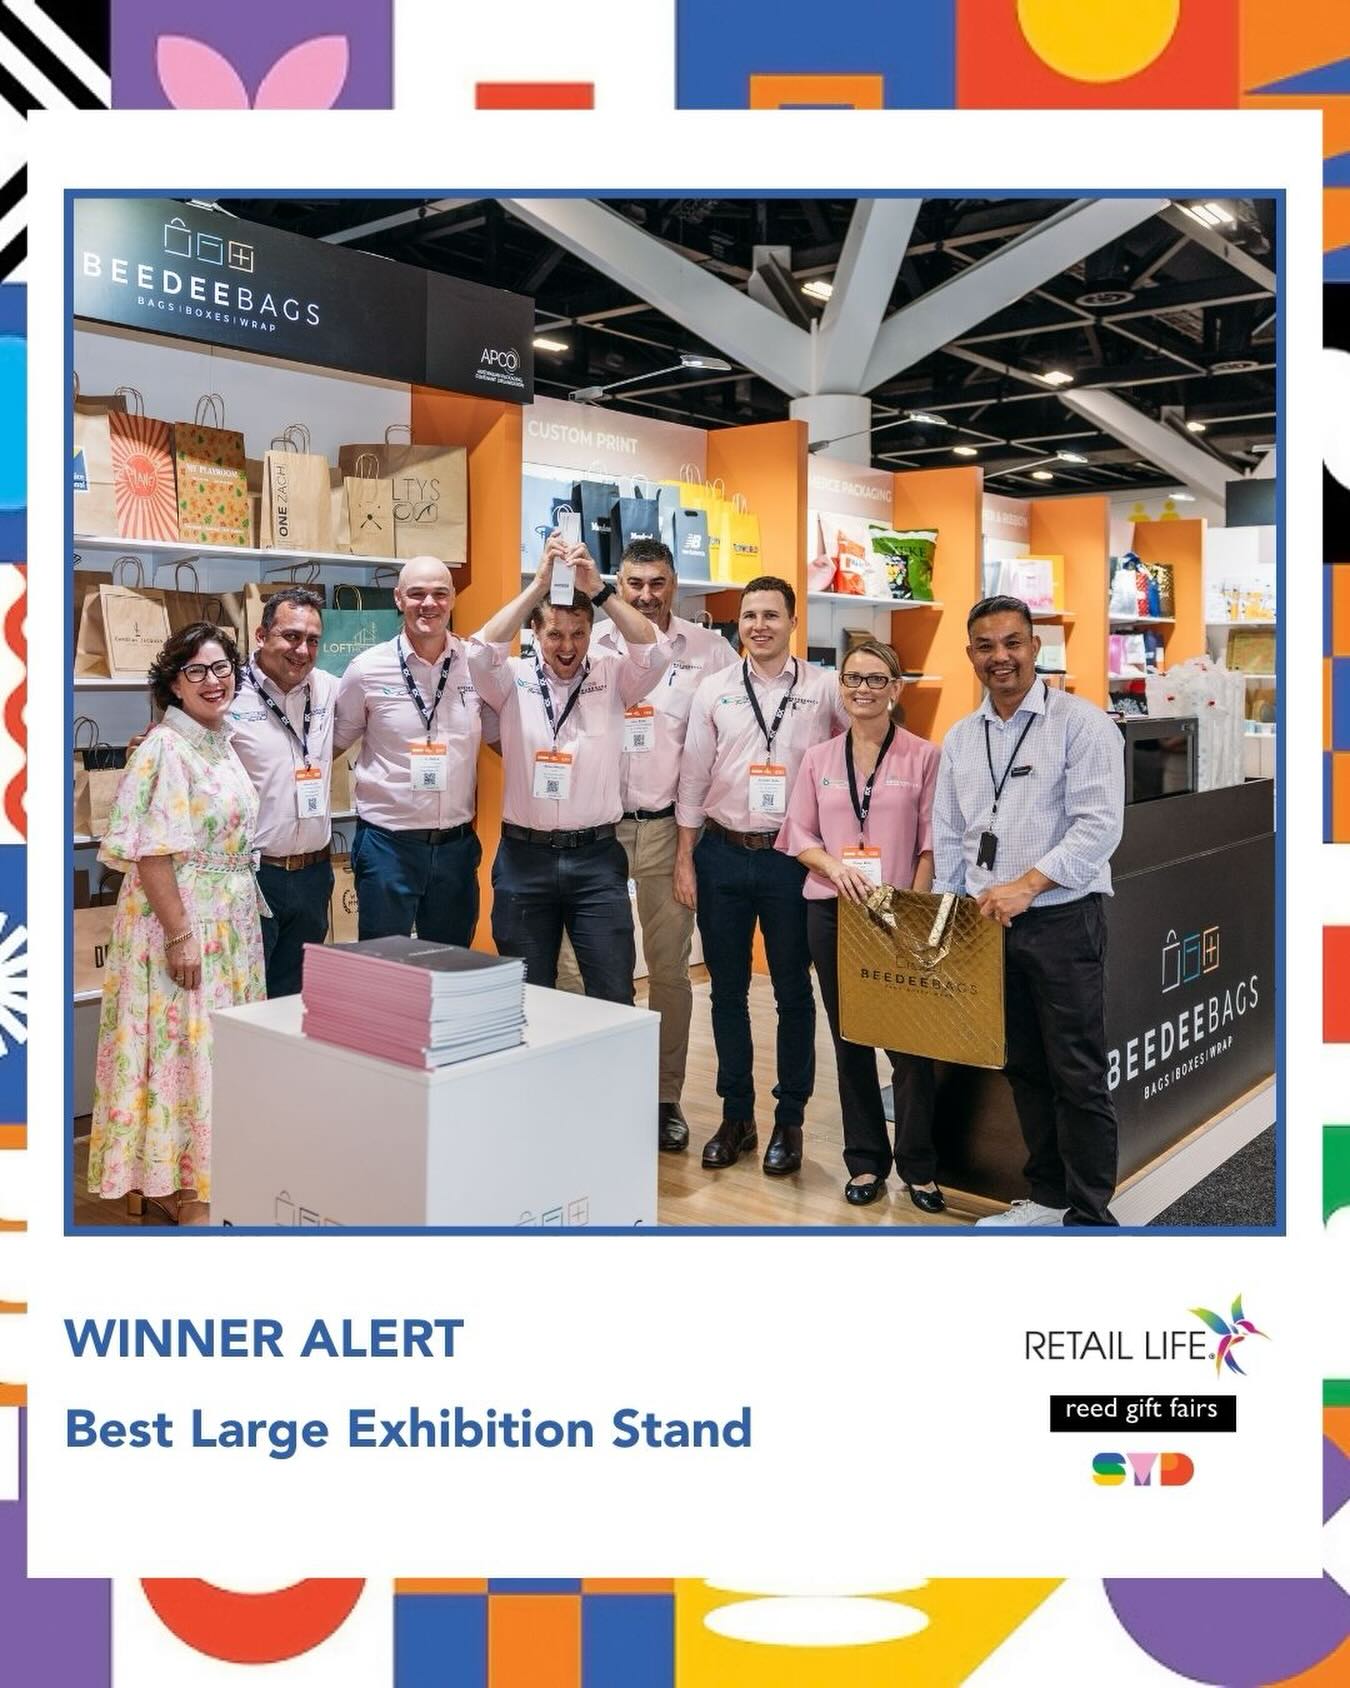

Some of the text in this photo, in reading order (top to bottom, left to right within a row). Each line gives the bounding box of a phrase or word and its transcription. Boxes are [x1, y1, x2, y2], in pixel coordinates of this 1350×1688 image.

[83, 251, 320, 326] BEEDEEBAGS
[480, 348, 518, 368] APCO
[527, 420, 638, 455] CUSTOM PRINT
[279, 506, 288, 537] ONE
[860, 968, 978, 996] BEEDEEBAGS
[1107, 975, 1258, 1091] BEEDEEBAGS
